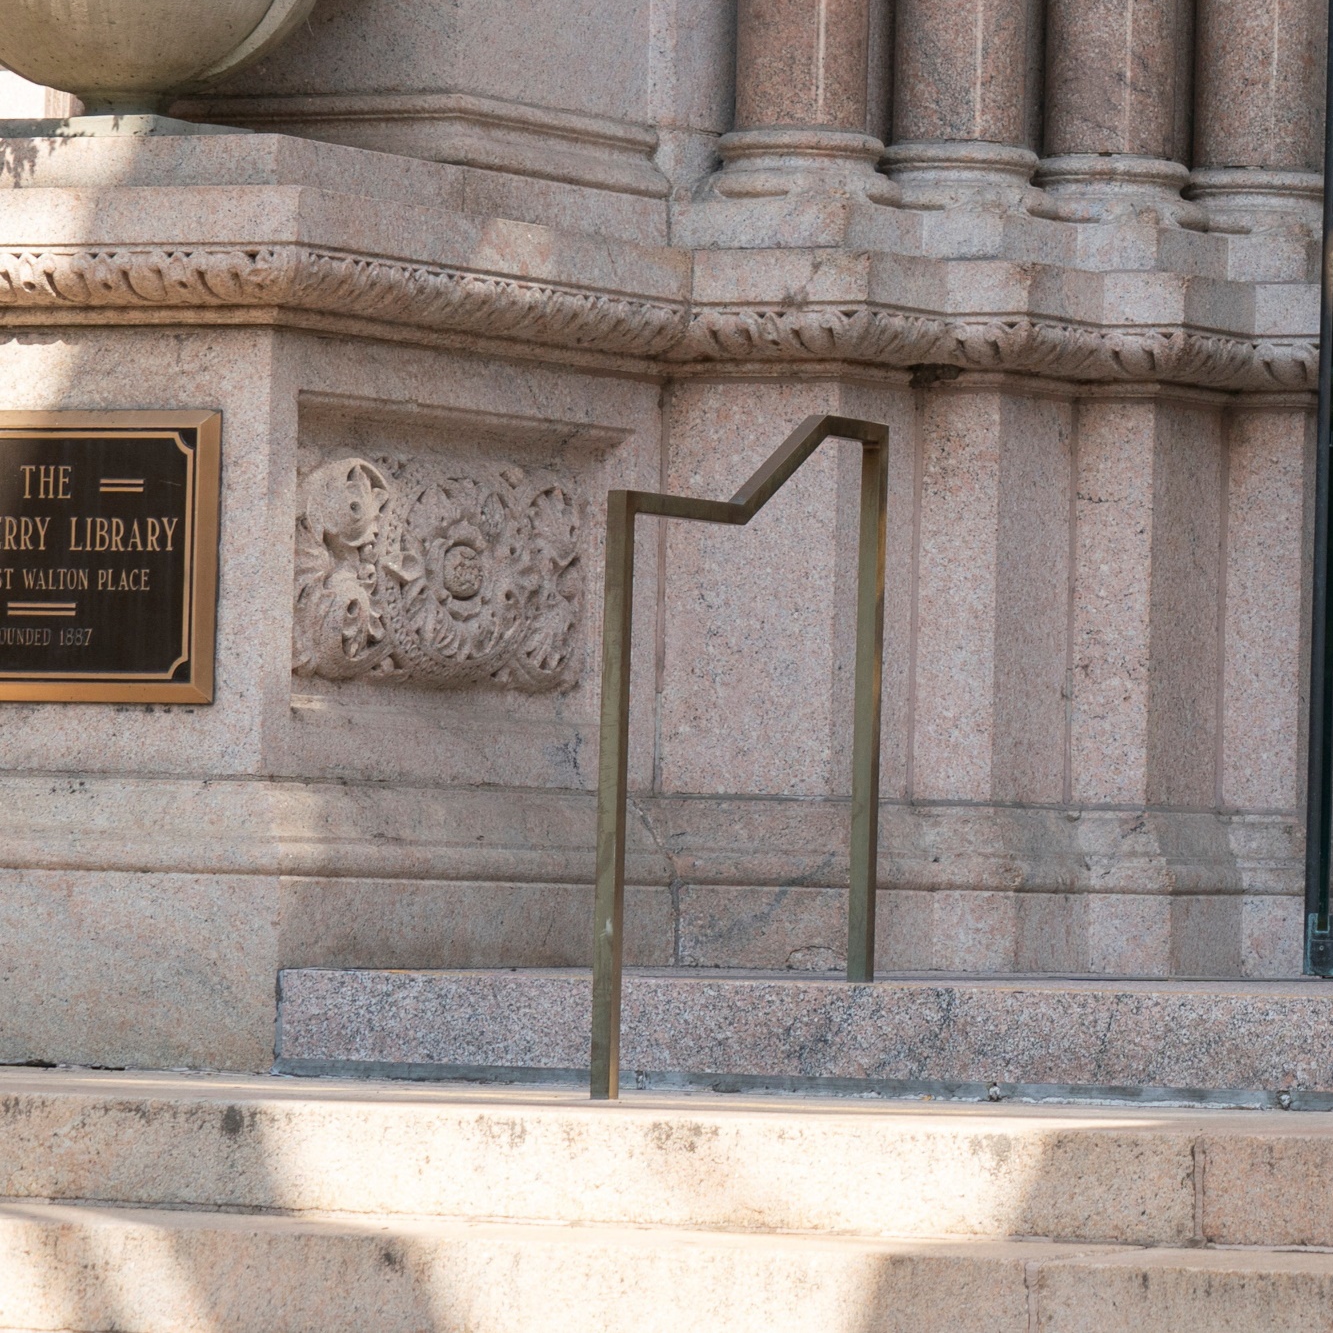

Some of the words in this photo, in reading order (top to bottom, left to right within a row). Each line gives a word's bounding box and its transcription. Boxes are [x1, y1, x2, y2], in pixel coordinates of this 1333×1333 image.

[20, 465, 72, 499] THE
[0, 517, 50, 551] RRY
[69, 517, 178, 551] LIBRARY
[23, 568, 89, 590] WALTON
[98, 569, 149, 591] PLACE
[60, 627, 93, 646] 1887
